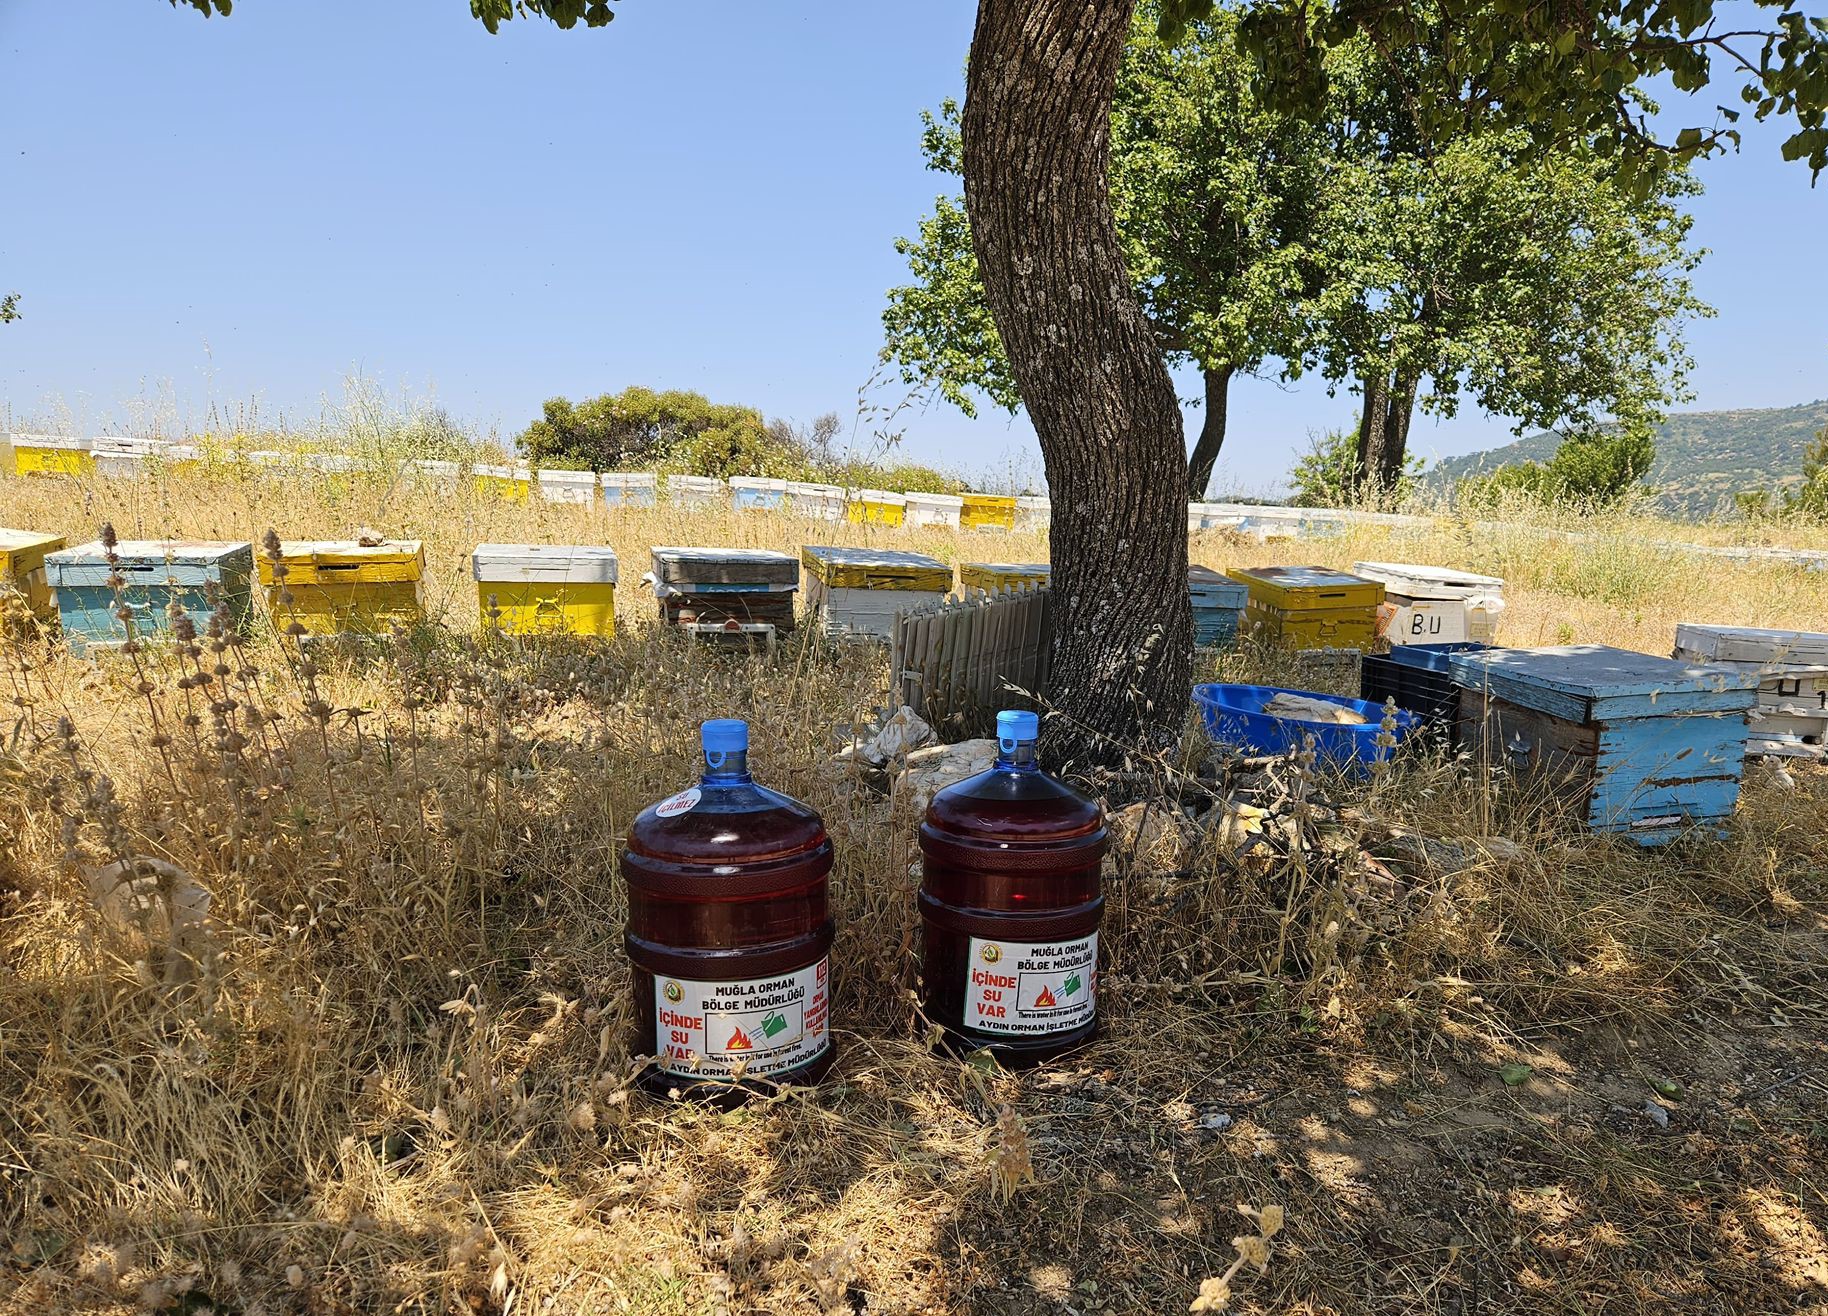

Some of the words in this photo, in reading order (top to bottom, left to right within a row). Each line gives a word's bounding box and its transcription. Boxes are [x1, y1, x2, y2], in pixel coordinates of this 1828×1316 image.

[1411, 613, 1441, 635] B.U
[1031, 946, 1063, 957] MUĞLA
[1064, 941, 1089, 955] ORMAN
[1017, 959, 1050, 970] BÖLGE
[1052, 950, 1092, 969] MÜDÜRLÜĞÜ
[972, 967, 1017, 988] İÇİNDE
[715, 984, 756, 997] MUĞLA
[758, 978, 795, 993] ORMAN
[983, 989, 1002, 1002] SU
[702, 998, 740, 1010] BÖLGE
[744, 986, 805, 1010] MÜDÜRLÜĞÜ
[659, 1007, 703, 1030] İÇİNDE
[977, 1002, 1006, 1018] VAR
[979, 1020, 1010, 1031] AYDIN
[1010, 1023, 1045, 1031] ORMAN
[1046, 1017, 1077, 1031] İŞLETME
[671, 1030, 689, 1045] SU
[702, 1068, 733, 1076] ORMA
